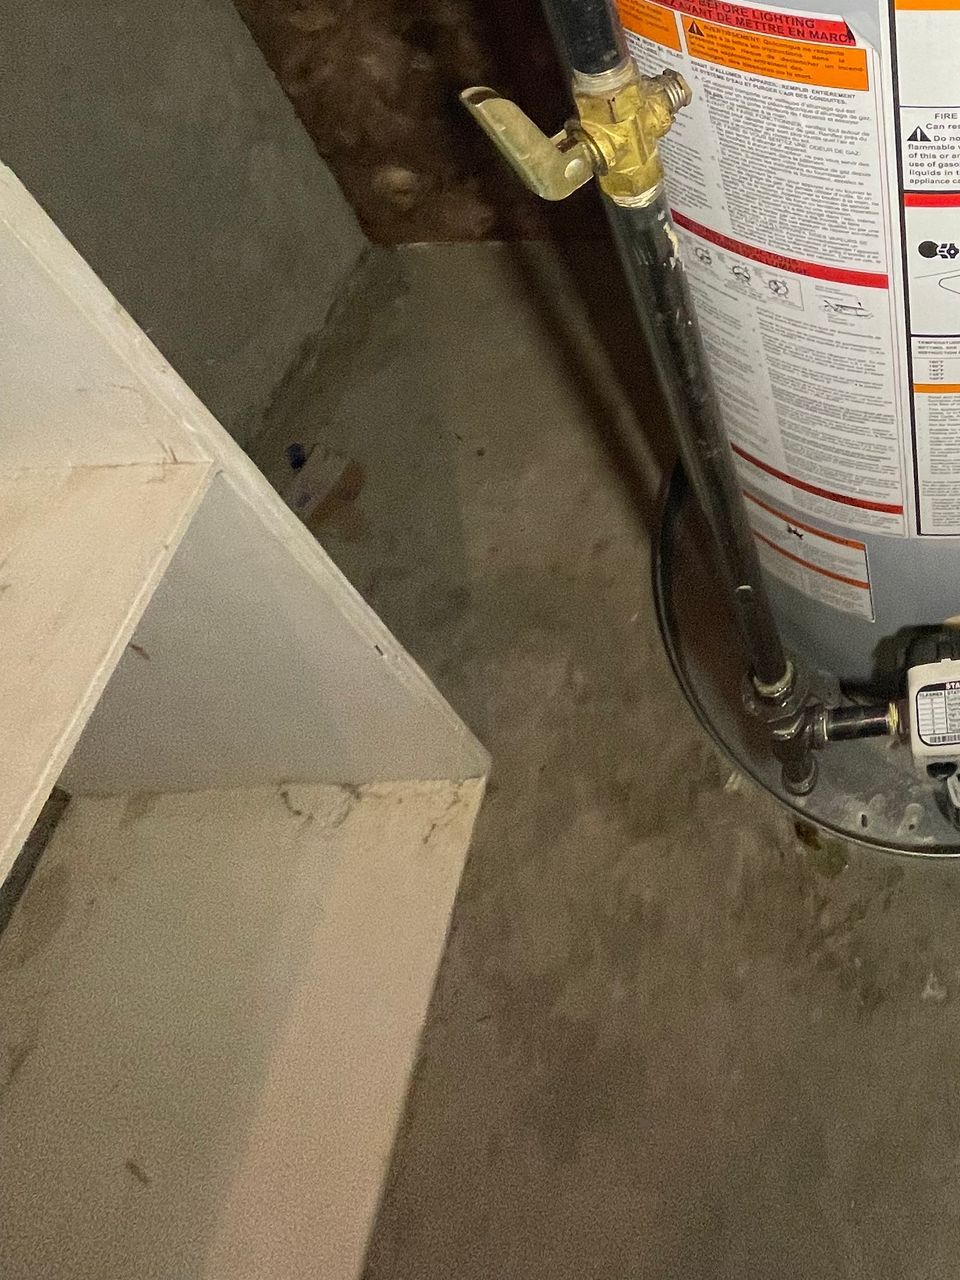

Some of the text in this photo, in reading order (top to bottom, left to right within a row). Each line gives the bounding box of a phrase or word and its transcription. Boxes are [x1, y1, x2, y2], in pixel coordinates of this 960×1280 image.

[716, 13, 733, 23] DE
[735, 17, 785, 34] METTRE
[788, 27, 805, 38] EN
[752, 5, 815, 29] LIGHTING
